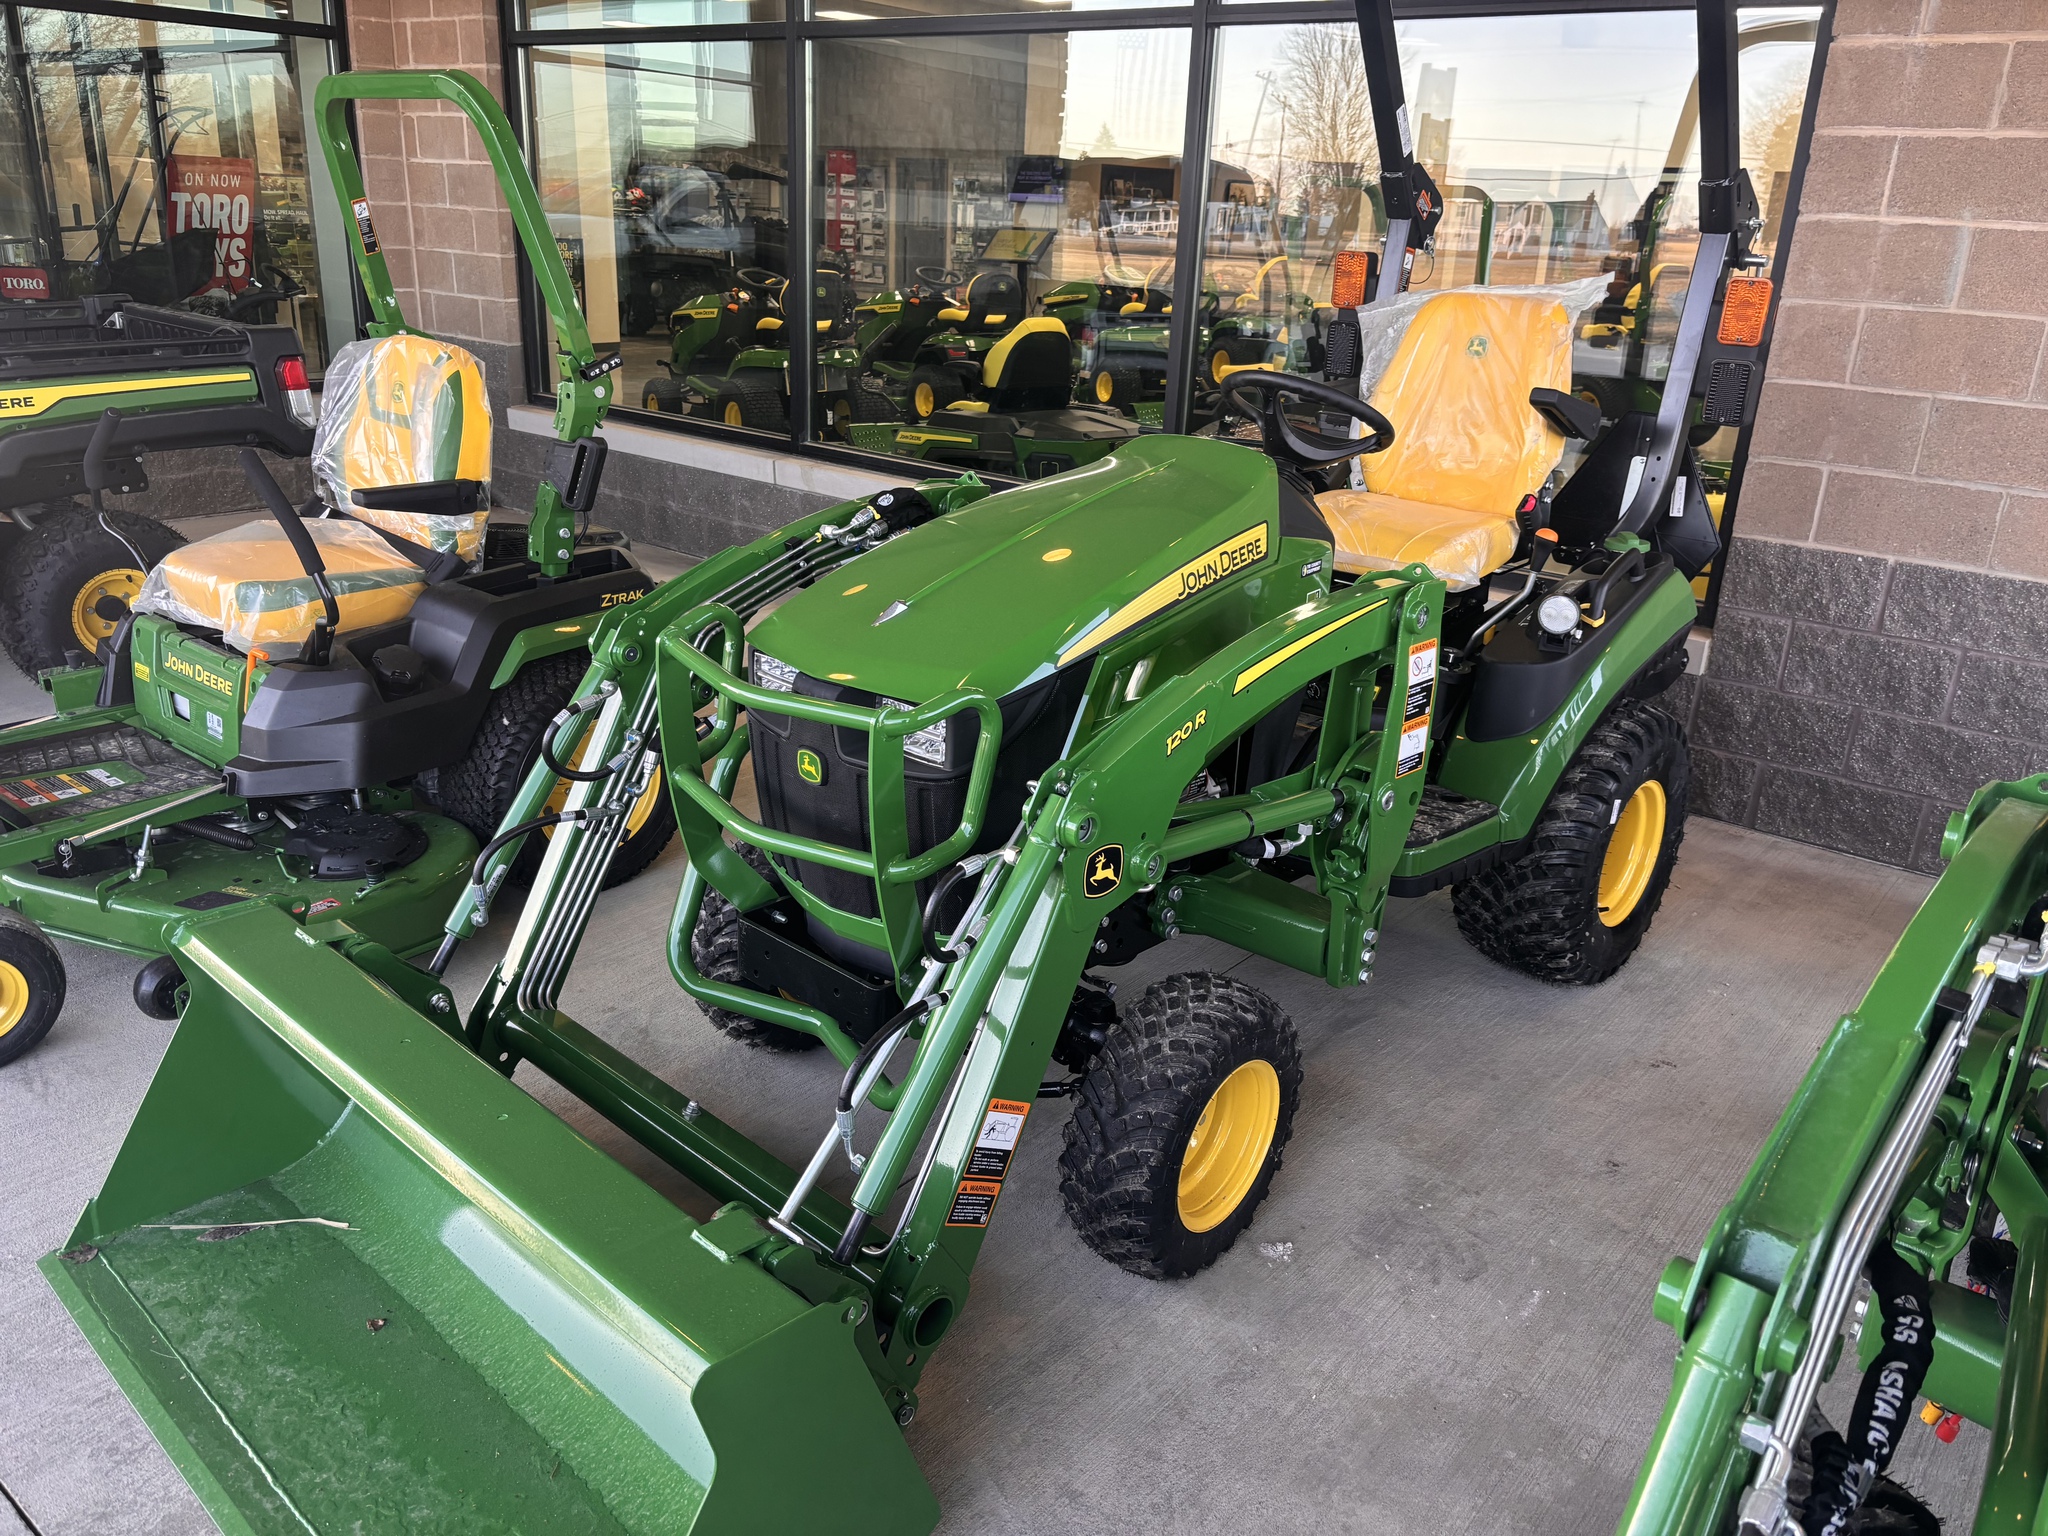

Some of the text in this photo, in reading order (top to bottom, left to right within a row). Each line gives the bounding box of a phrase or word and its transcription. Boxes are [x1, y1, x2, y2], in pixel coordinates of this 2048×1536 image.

[184, 172, 241, 188] ON NOW
[171, 192, 249, 235] TORO
[215, 237, 246, 278] YS
[560, 250, 574, 260] ORE
[0, 396, 35, 409] ERE
[1178, 538, 1263, 598] JOHN DEERE
[601, 589, 644, 608] ZTRAK
[165, 651, 194, 679] JOHN
[195, 664, 233, 697] DEERE
[999, 1103, 1025, 1113] WARNING
[970, 1184, 996, 1194] WARNING
